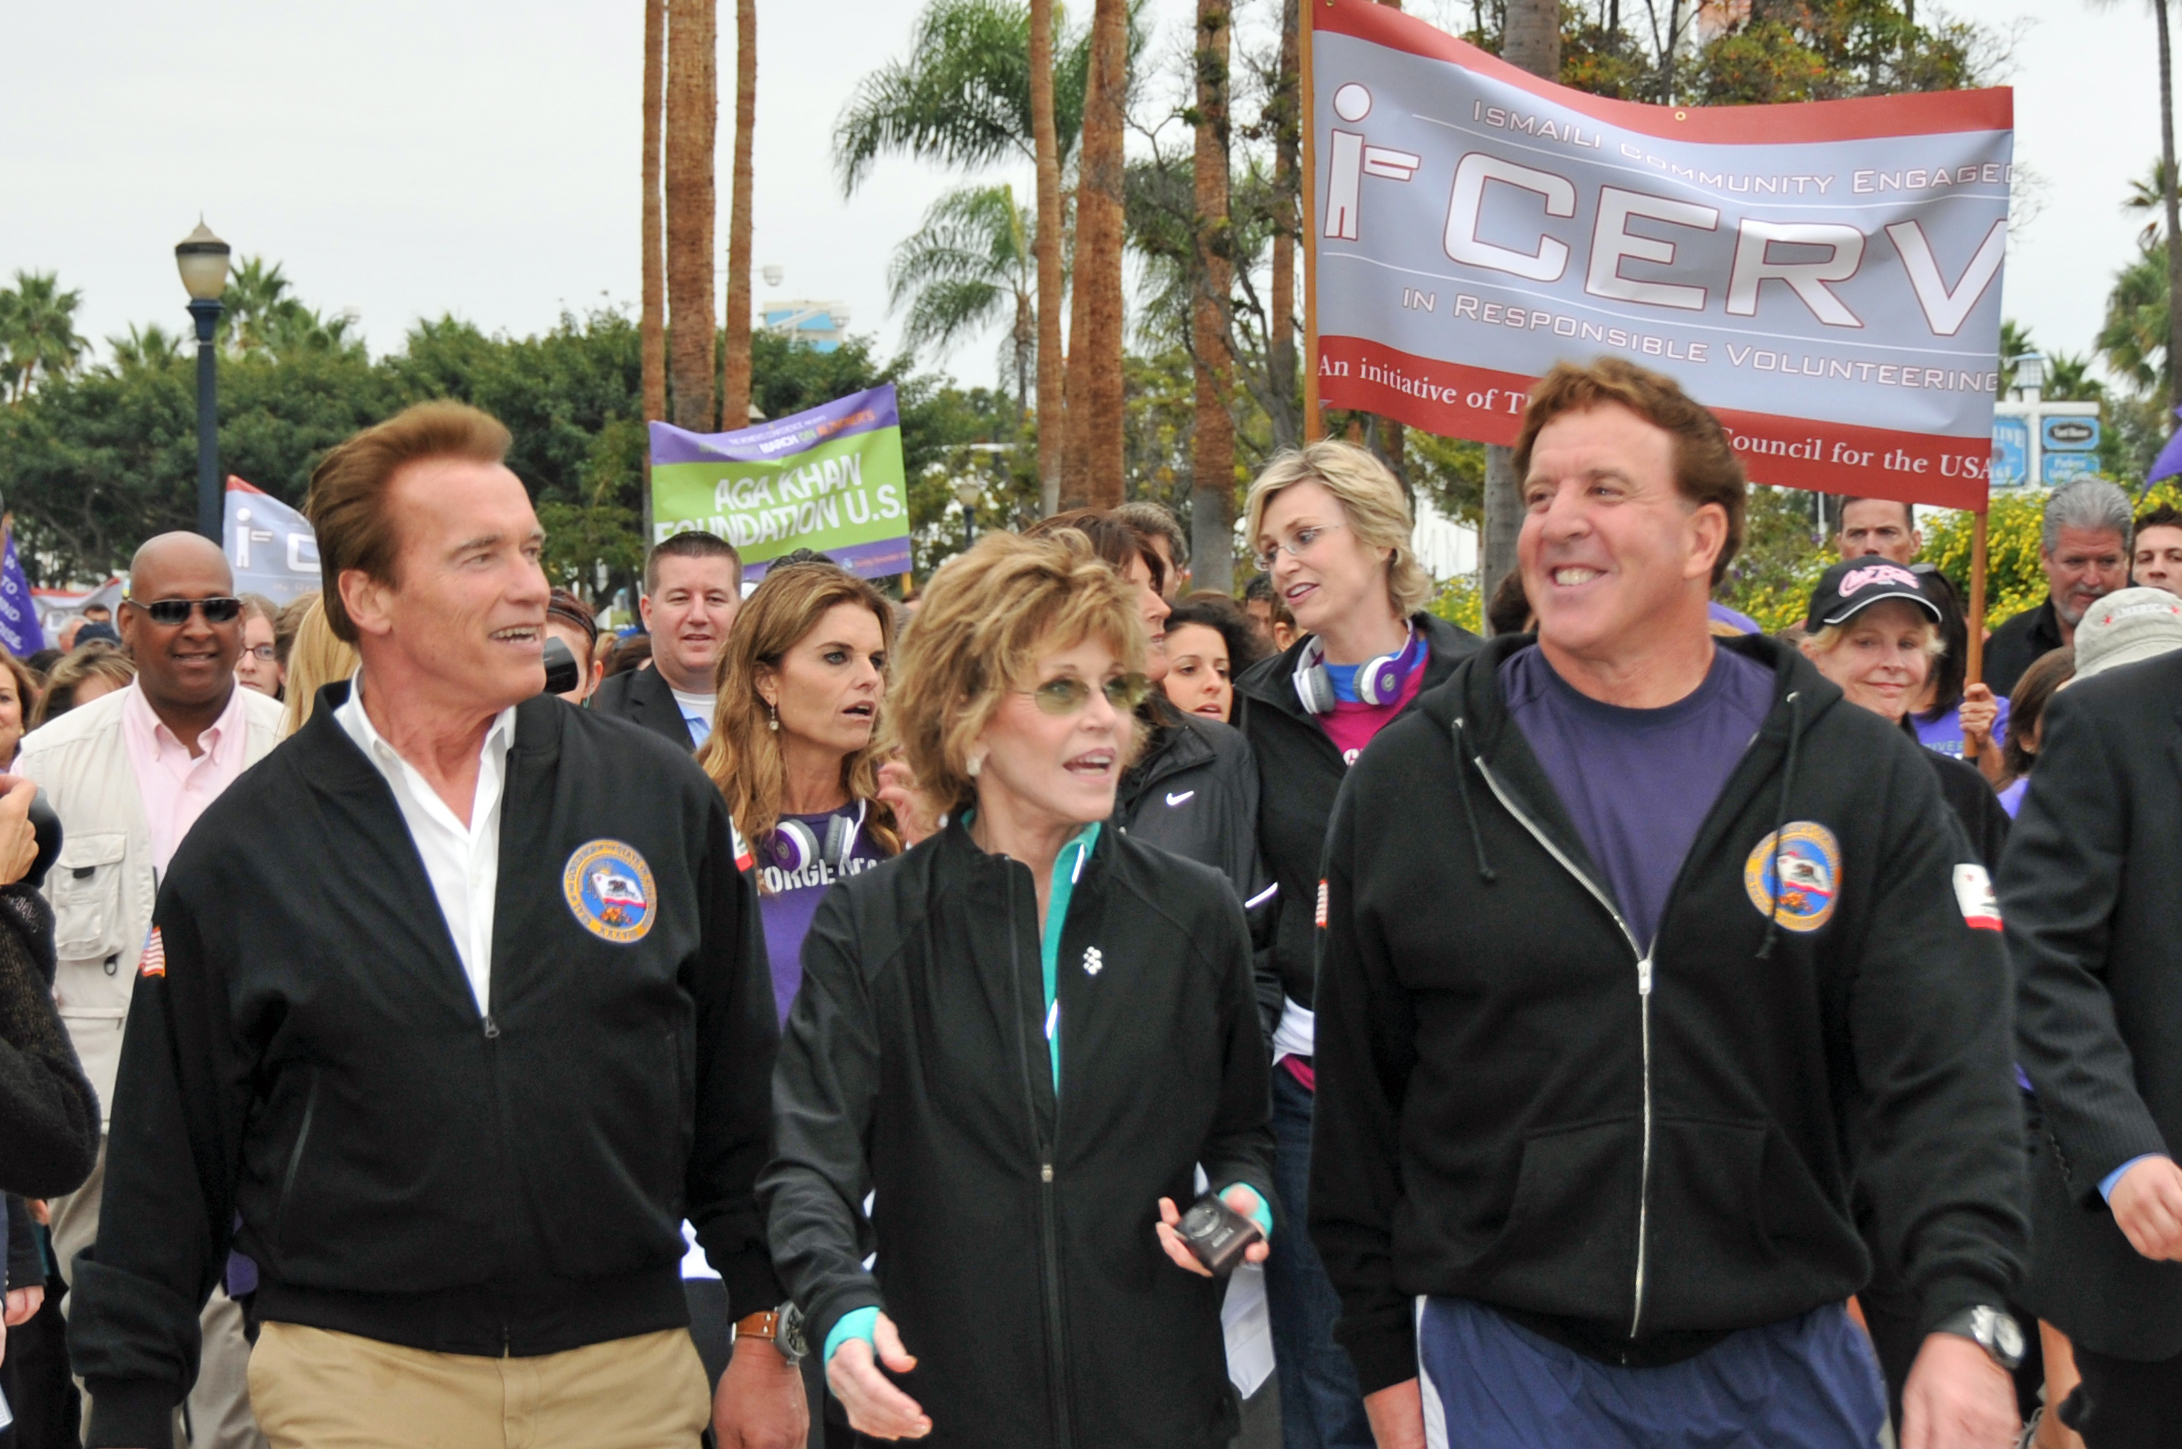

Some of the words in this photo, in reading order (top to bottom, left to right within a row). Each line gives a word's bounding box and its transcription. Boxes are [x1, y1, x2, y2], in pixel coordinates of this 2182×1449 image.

[1472, 99, 1601, 149] ISMAILI
[1619, 142, 1834, 195] COMMUNITY
[1443, 151, 2008, 337] CERV
[1402, 287, 1436, 313] IN
[1453, 293, 1709, 364] RESPONSIBLE
[1317, 353, 1349, 377] An
[1359, 356, 1458, 405] initiative
[1466, 388, 1499, 411] of
[714, 475, 775, 513] AGA
[777, 452, 863, 503] KHAN
[1830, 441, 1875, 467] for
[1883, 448, 1929, 474] the
[844, 483, 908, 525] U.S.
